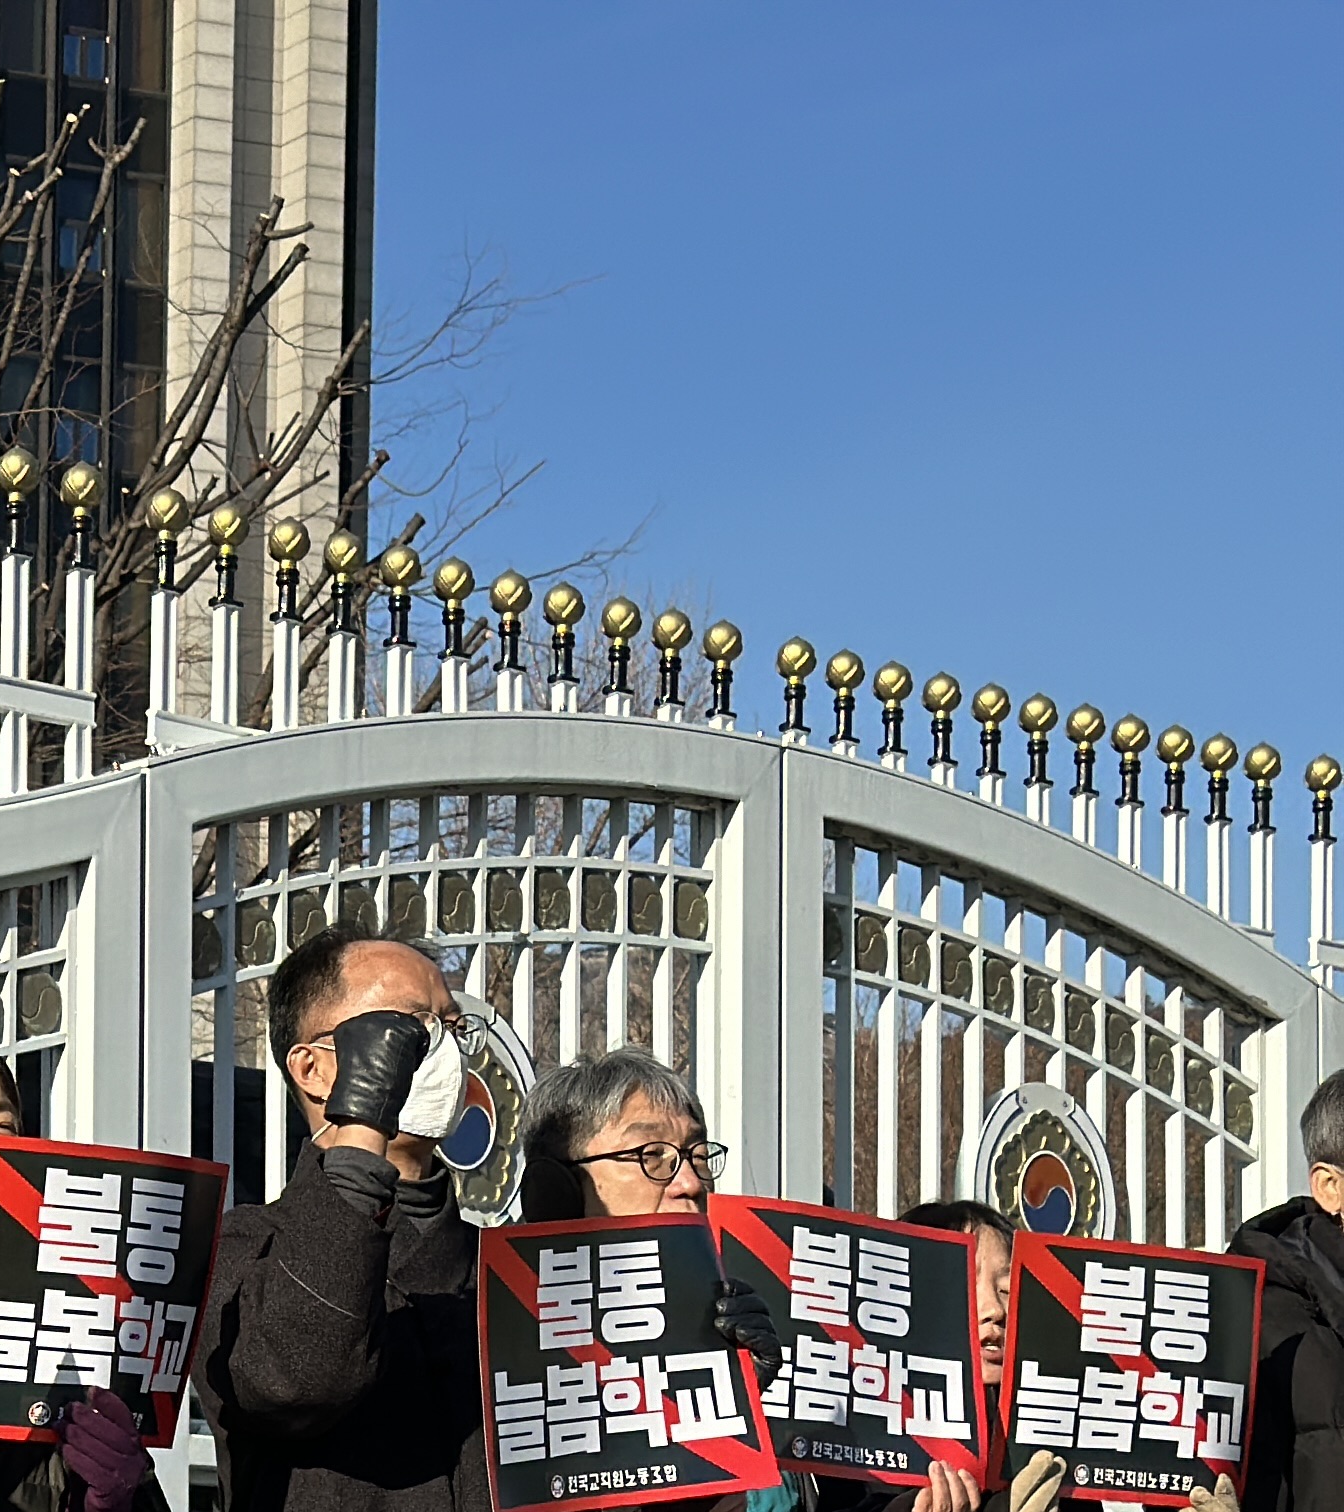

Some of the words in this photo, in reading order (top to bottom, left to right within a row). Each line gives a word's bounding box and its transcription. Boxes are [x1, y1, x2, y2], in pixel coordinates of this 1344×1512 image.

[36, 1168, 185, 1284] 불통
[789, 1226, 912, 1338] 불통
[537, 1239, 666, 1351] 불통
[1080, 1260, 1210, 1363] 불통
[494, 1349, 748, 1465] 늘봄학교
[1014, 1360, 1245, 1462] 늘봄학교
[568, 1464, 678, 1494] 전국교직원노동조합
